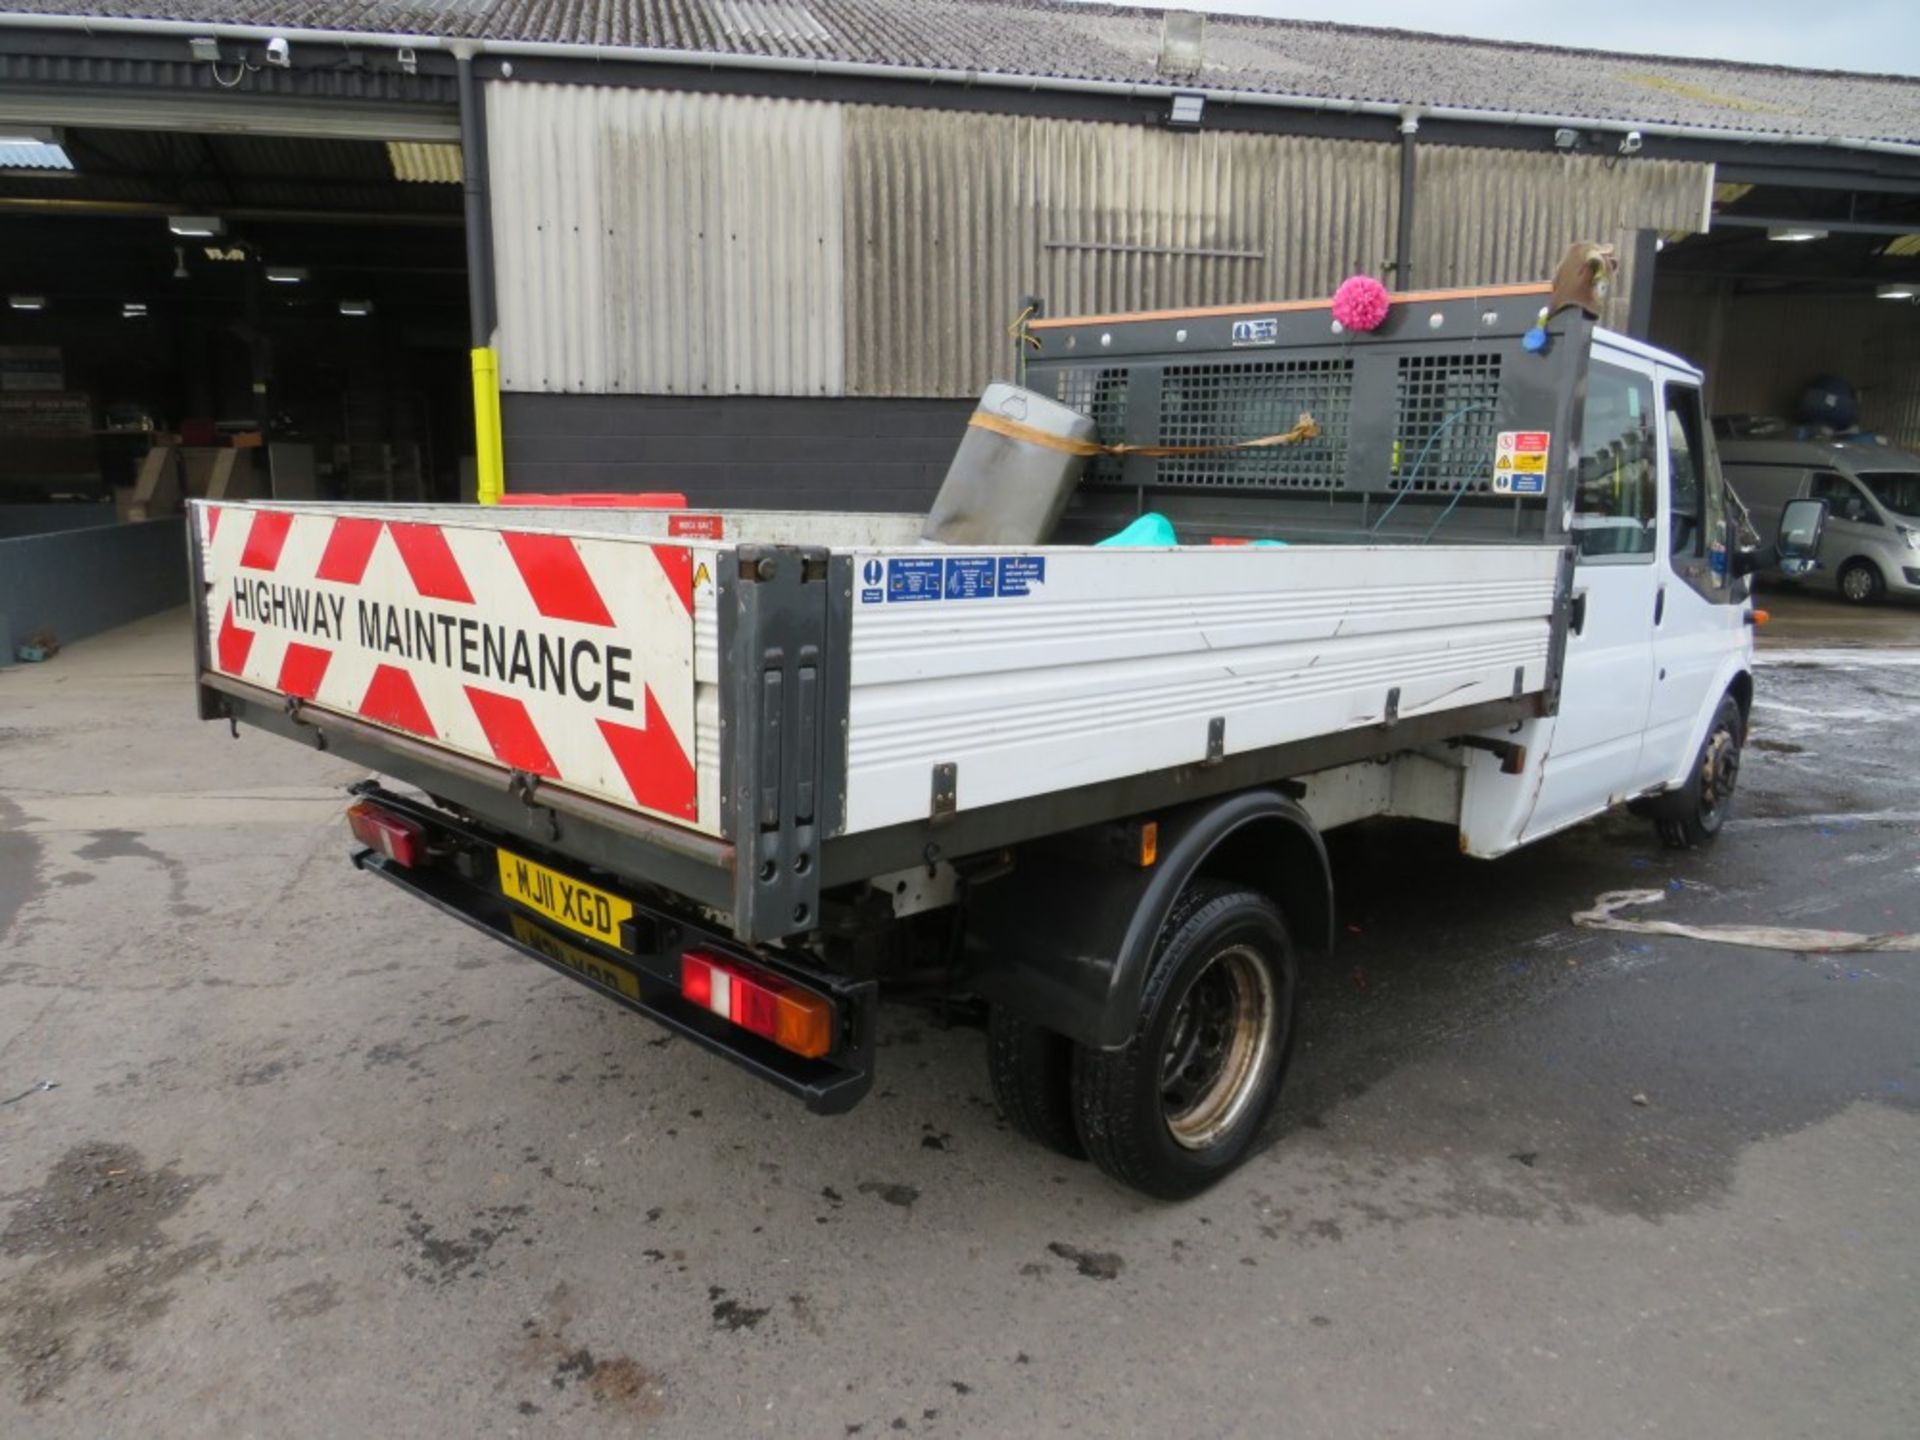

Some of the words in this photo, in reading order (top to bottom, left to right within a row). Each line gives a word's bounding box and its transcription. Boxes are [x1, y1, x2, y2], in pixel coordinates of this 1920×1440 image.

[232, 577, 346, 643] HIGHWAY
[358, 600, 635, 711] MAINTENANCE
[516, 860, 556, 912] MJ11
[560, 881, 612, 935] XGD
